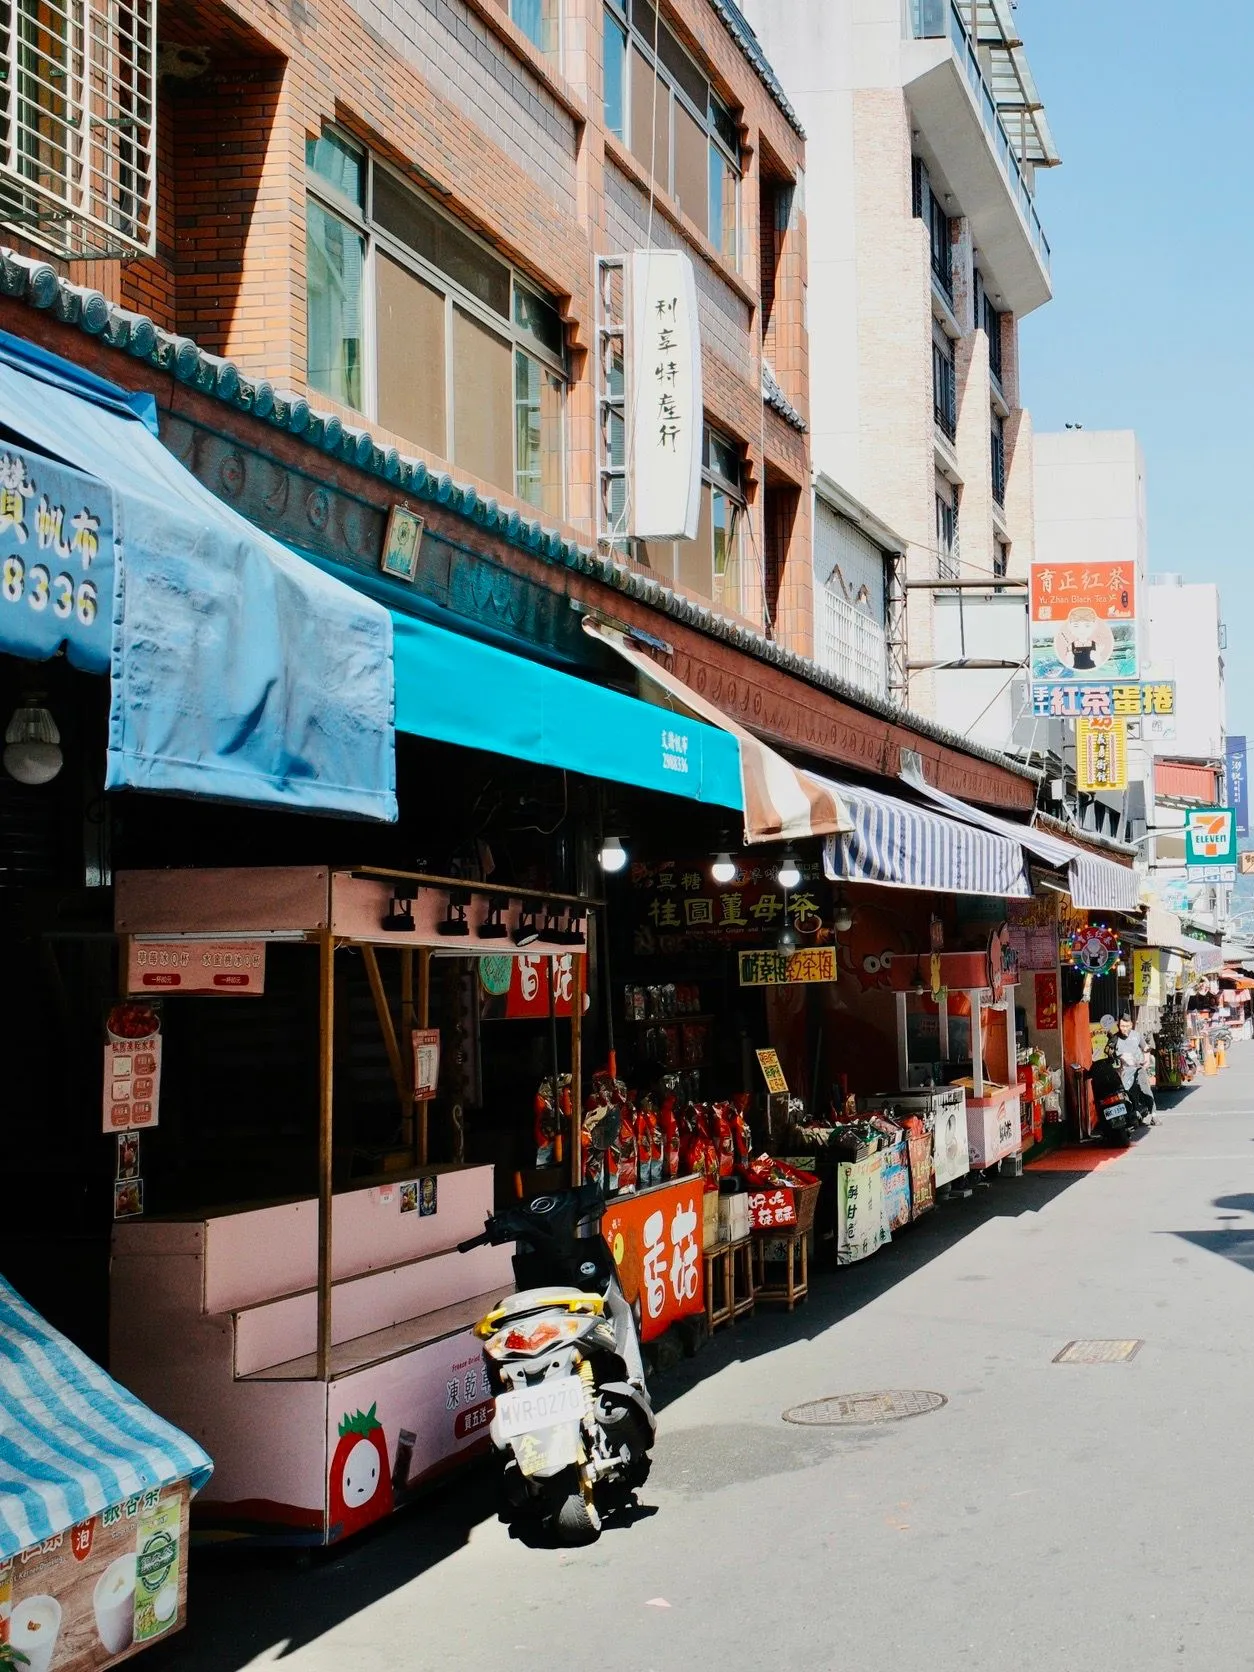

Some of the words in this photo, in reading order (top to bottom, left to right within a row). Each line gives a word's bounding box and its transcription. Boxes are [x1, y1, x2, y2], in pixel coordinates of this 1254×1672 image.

[1036, 567, 1131, 594] 育正紅茶
[648, 892, 820, 928] 桂圓薑母茶
[464, 1407, 494, 1432] 買五送一
